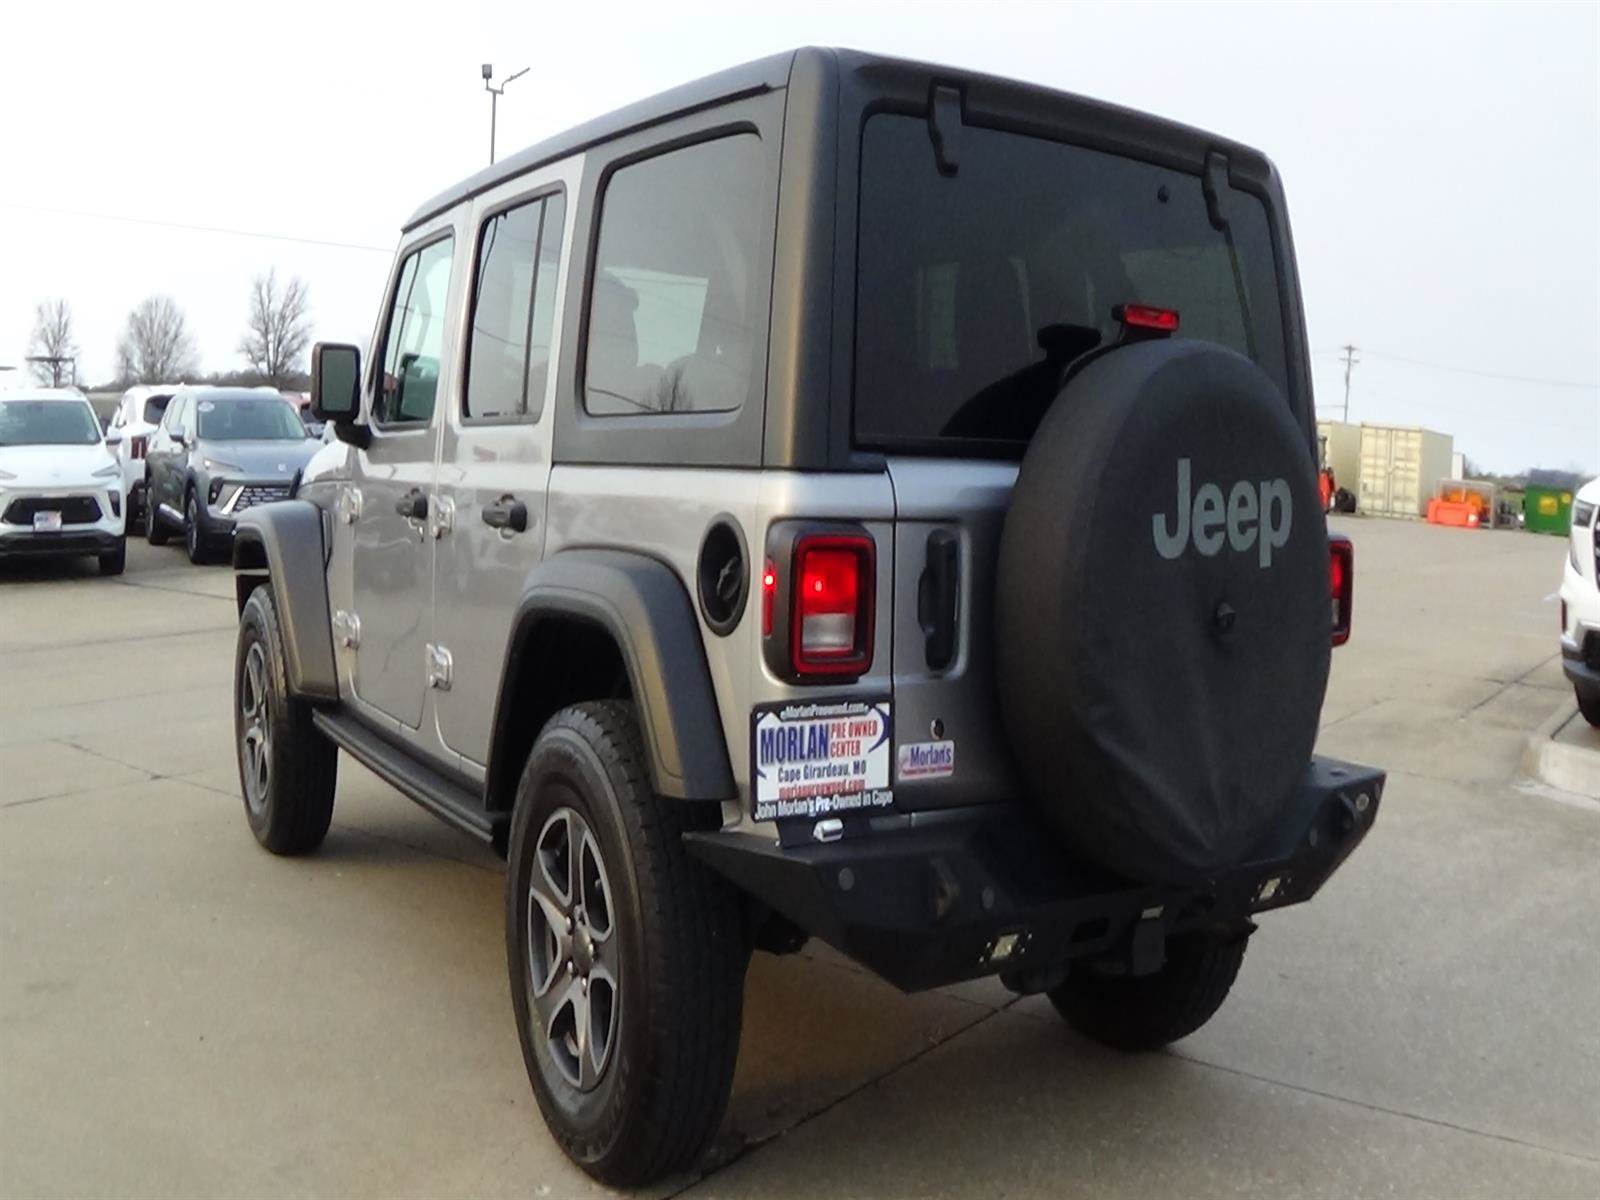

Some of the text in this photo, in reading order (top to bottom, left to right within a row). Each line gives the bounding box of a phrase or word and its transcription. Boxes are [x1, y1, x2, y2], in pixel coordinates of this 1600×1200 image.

[1152, 458, 1292, 569] Jeep
[831, 719, 878, 739] PRE OWNED
[760, 723, 829, 766] MORLAN
[830, 739, 861, 758] CENTER
[778, 766, 801, 783] Cape
[853, 760, 866, 775] MO
[755, 788, 894, 820] John Morlan's Pre-Owned in Cape
